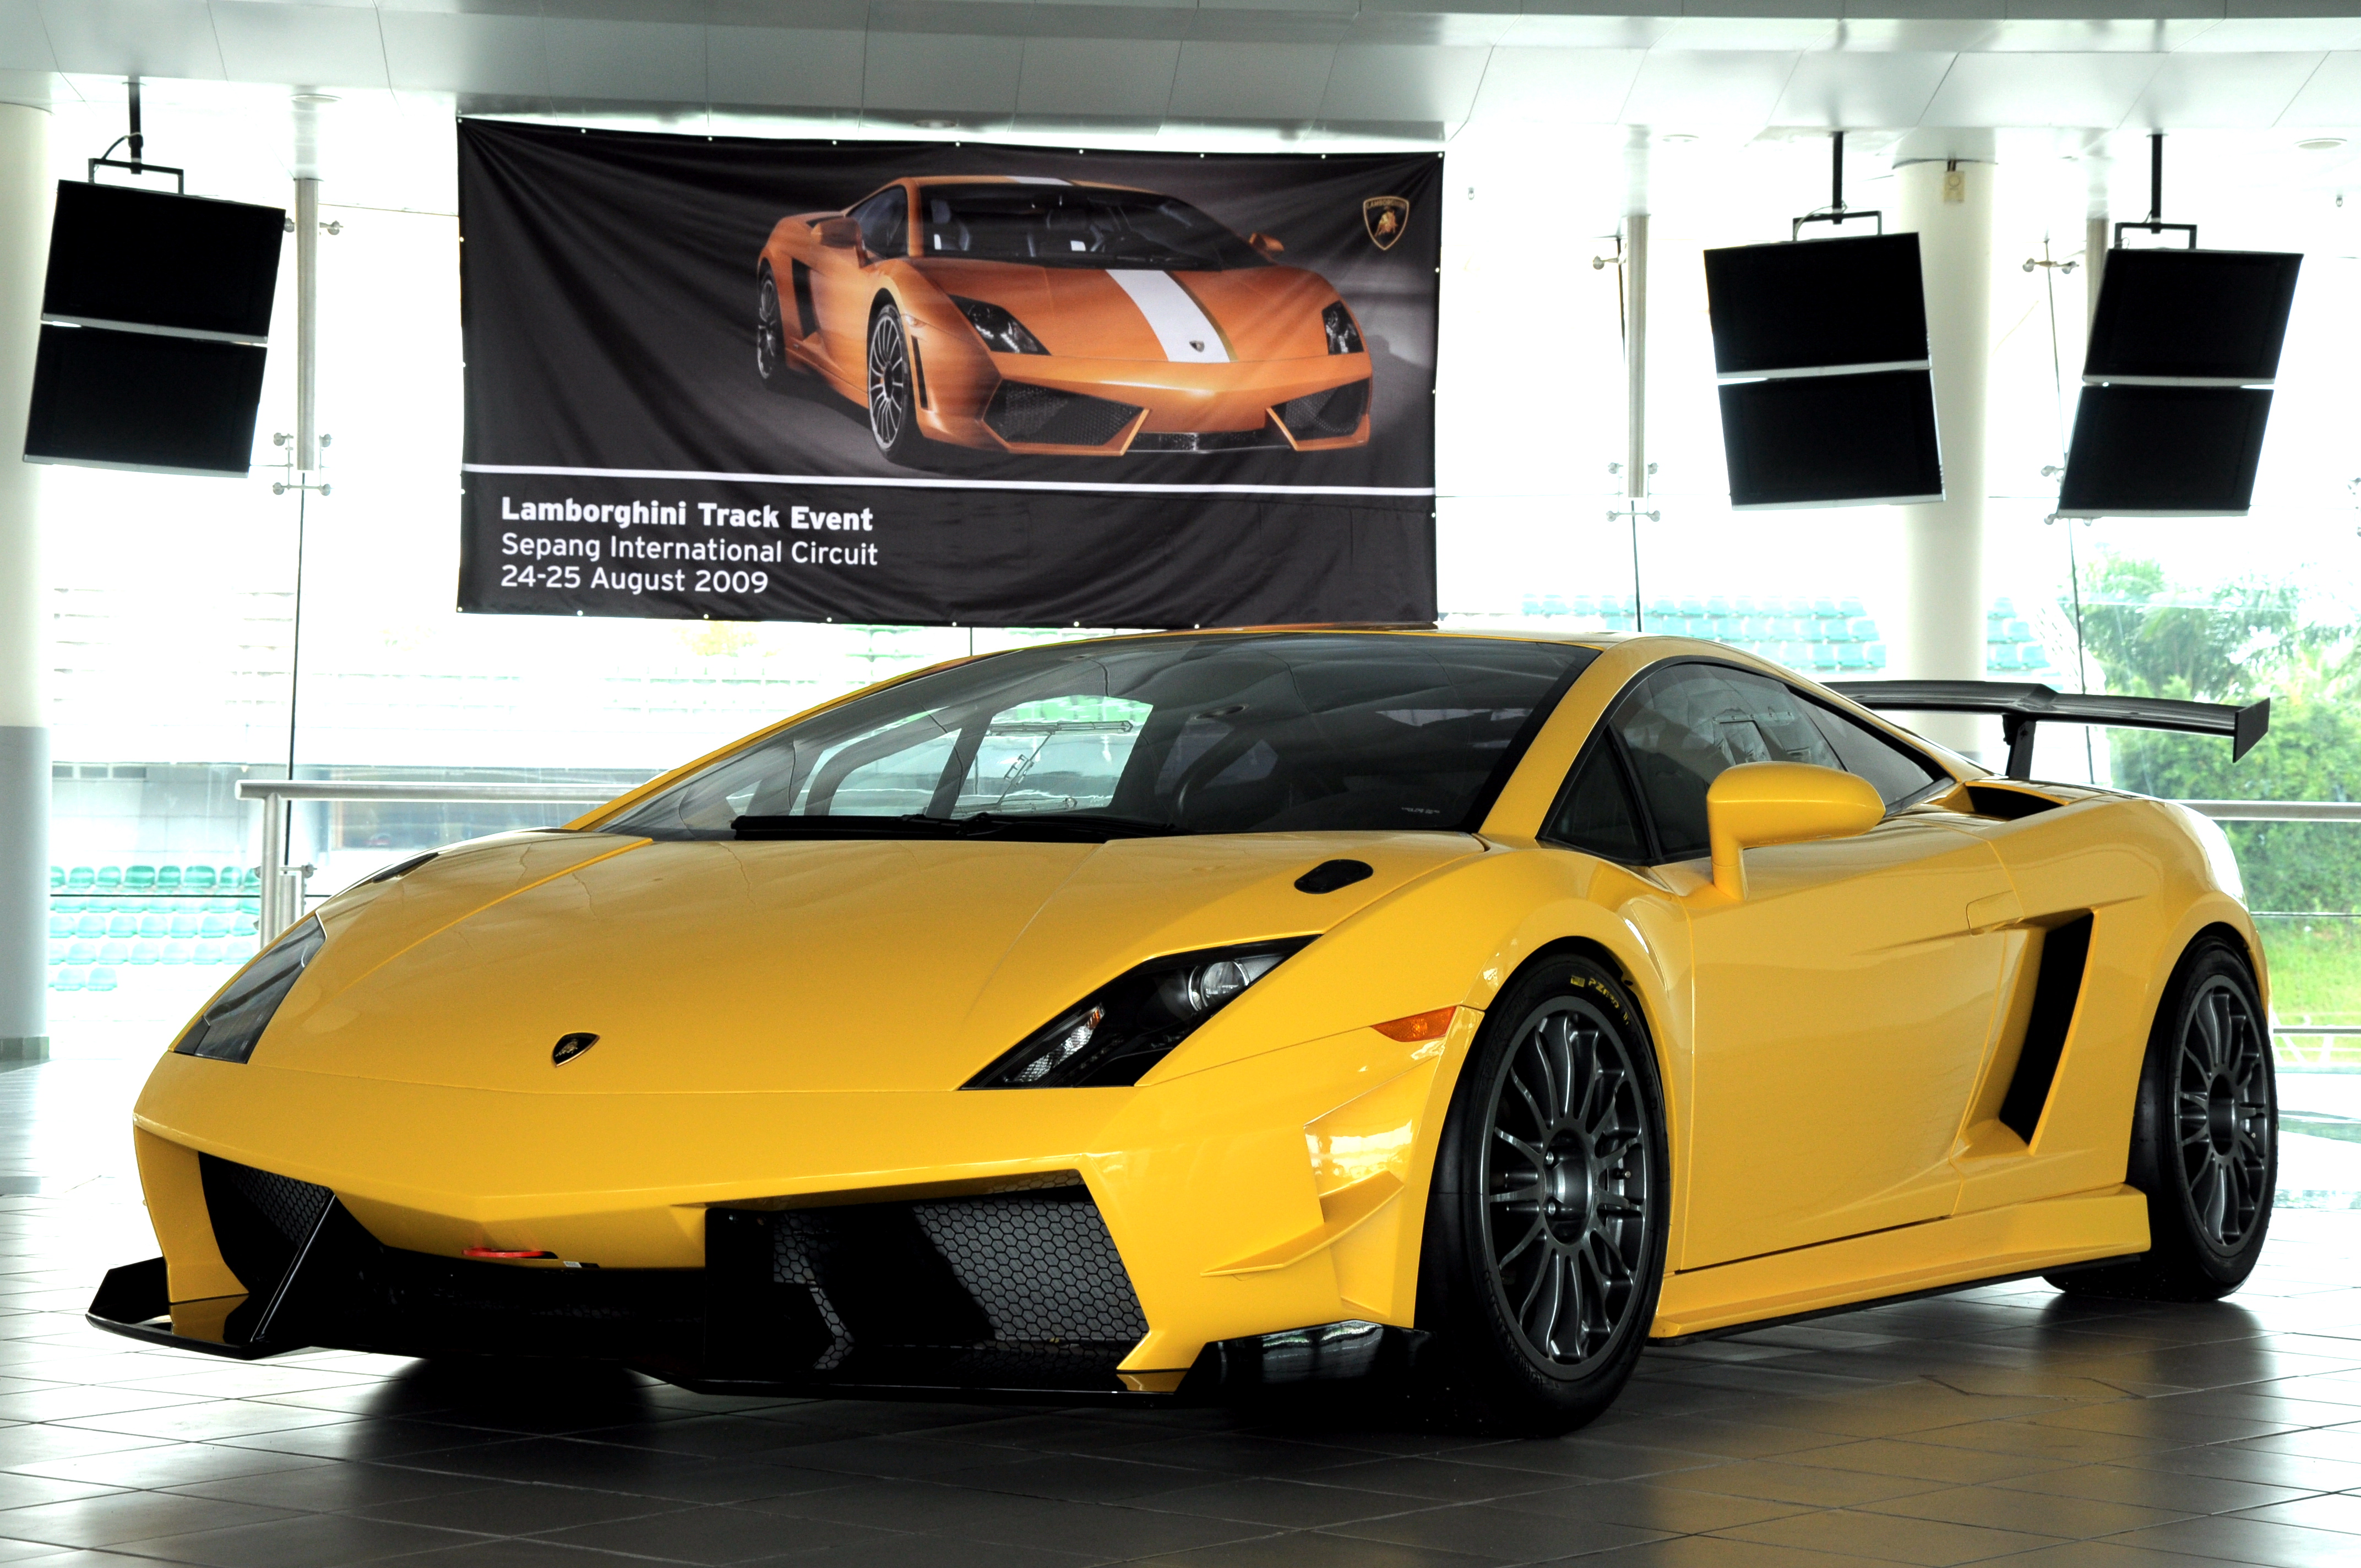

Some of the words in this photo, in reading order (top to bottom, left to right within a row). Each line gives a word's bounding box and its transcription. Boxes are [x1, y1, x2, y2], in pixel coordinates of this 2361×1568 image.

[502, 496, 687, 529] Lamborghini
[697, 502, 780, 529] Track
[791, 505, 873, 532] Event
[502, 532, 600, 562] Sepang
[611, 535, 782, 563] International
[791, 541, 878, 566] Circuit
[501, 564, 581, 589] 24-25
[590, 566, 686, 596] August
[694, 569, 769, 594] 2009
